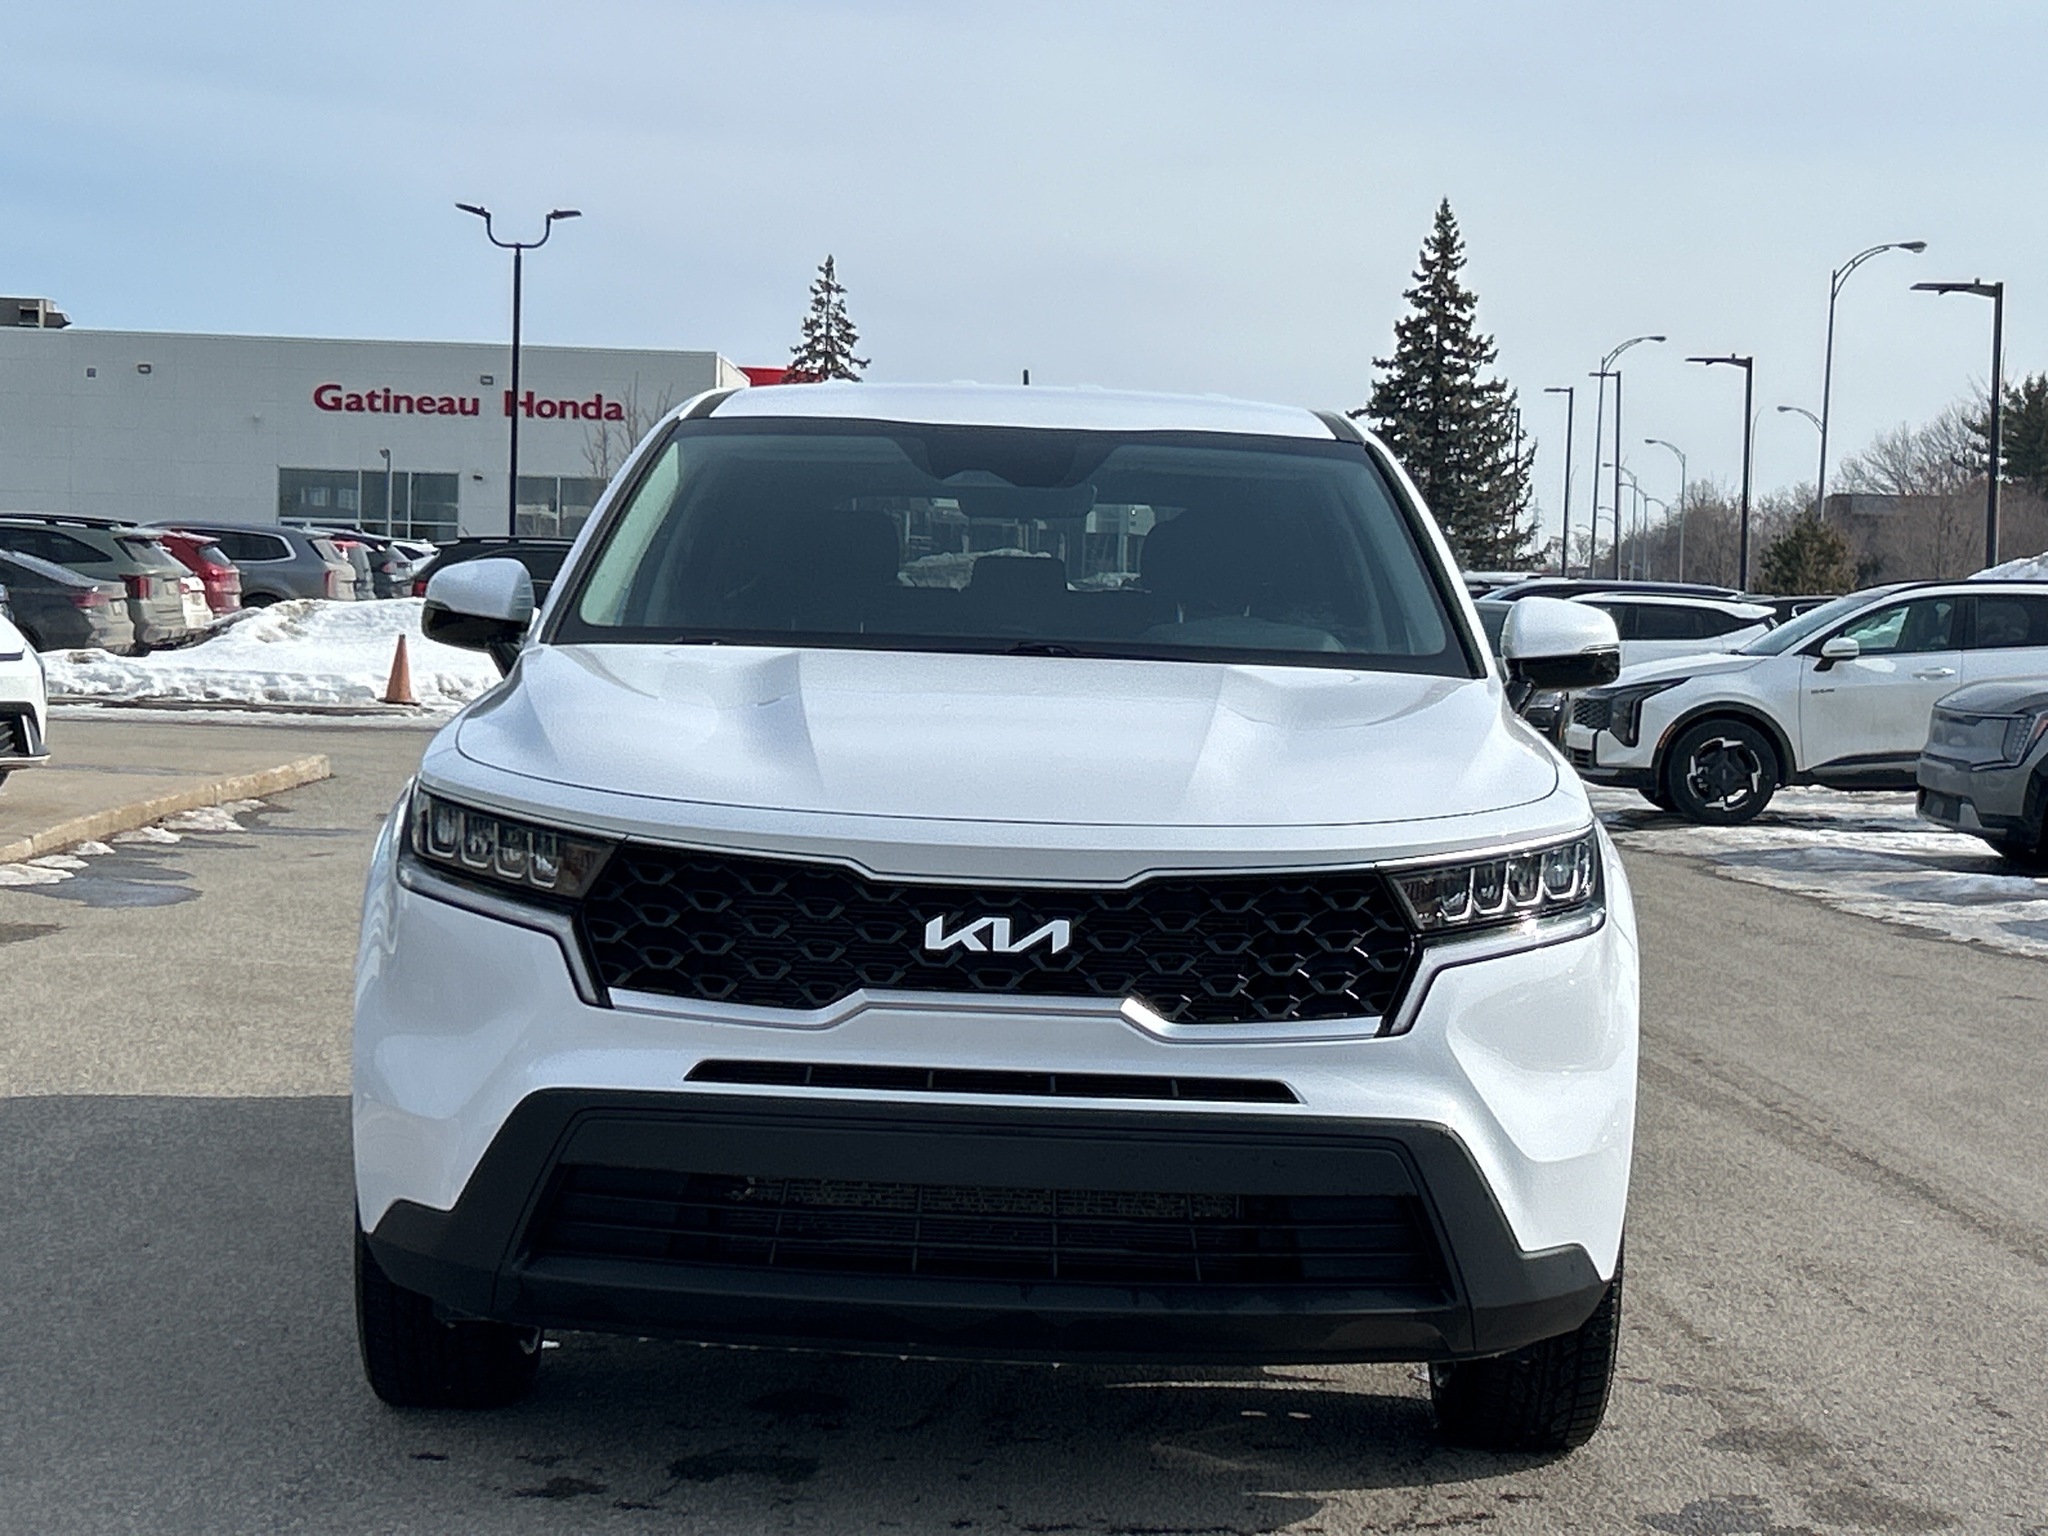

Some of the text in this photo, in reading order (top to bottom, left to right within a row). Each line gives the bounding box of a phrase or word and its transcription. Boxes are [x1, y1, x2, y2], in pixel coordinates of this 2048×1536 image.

[313, 384, 625, 421] Gatineau Honda
[925, 915, 1070, 954] KIA
